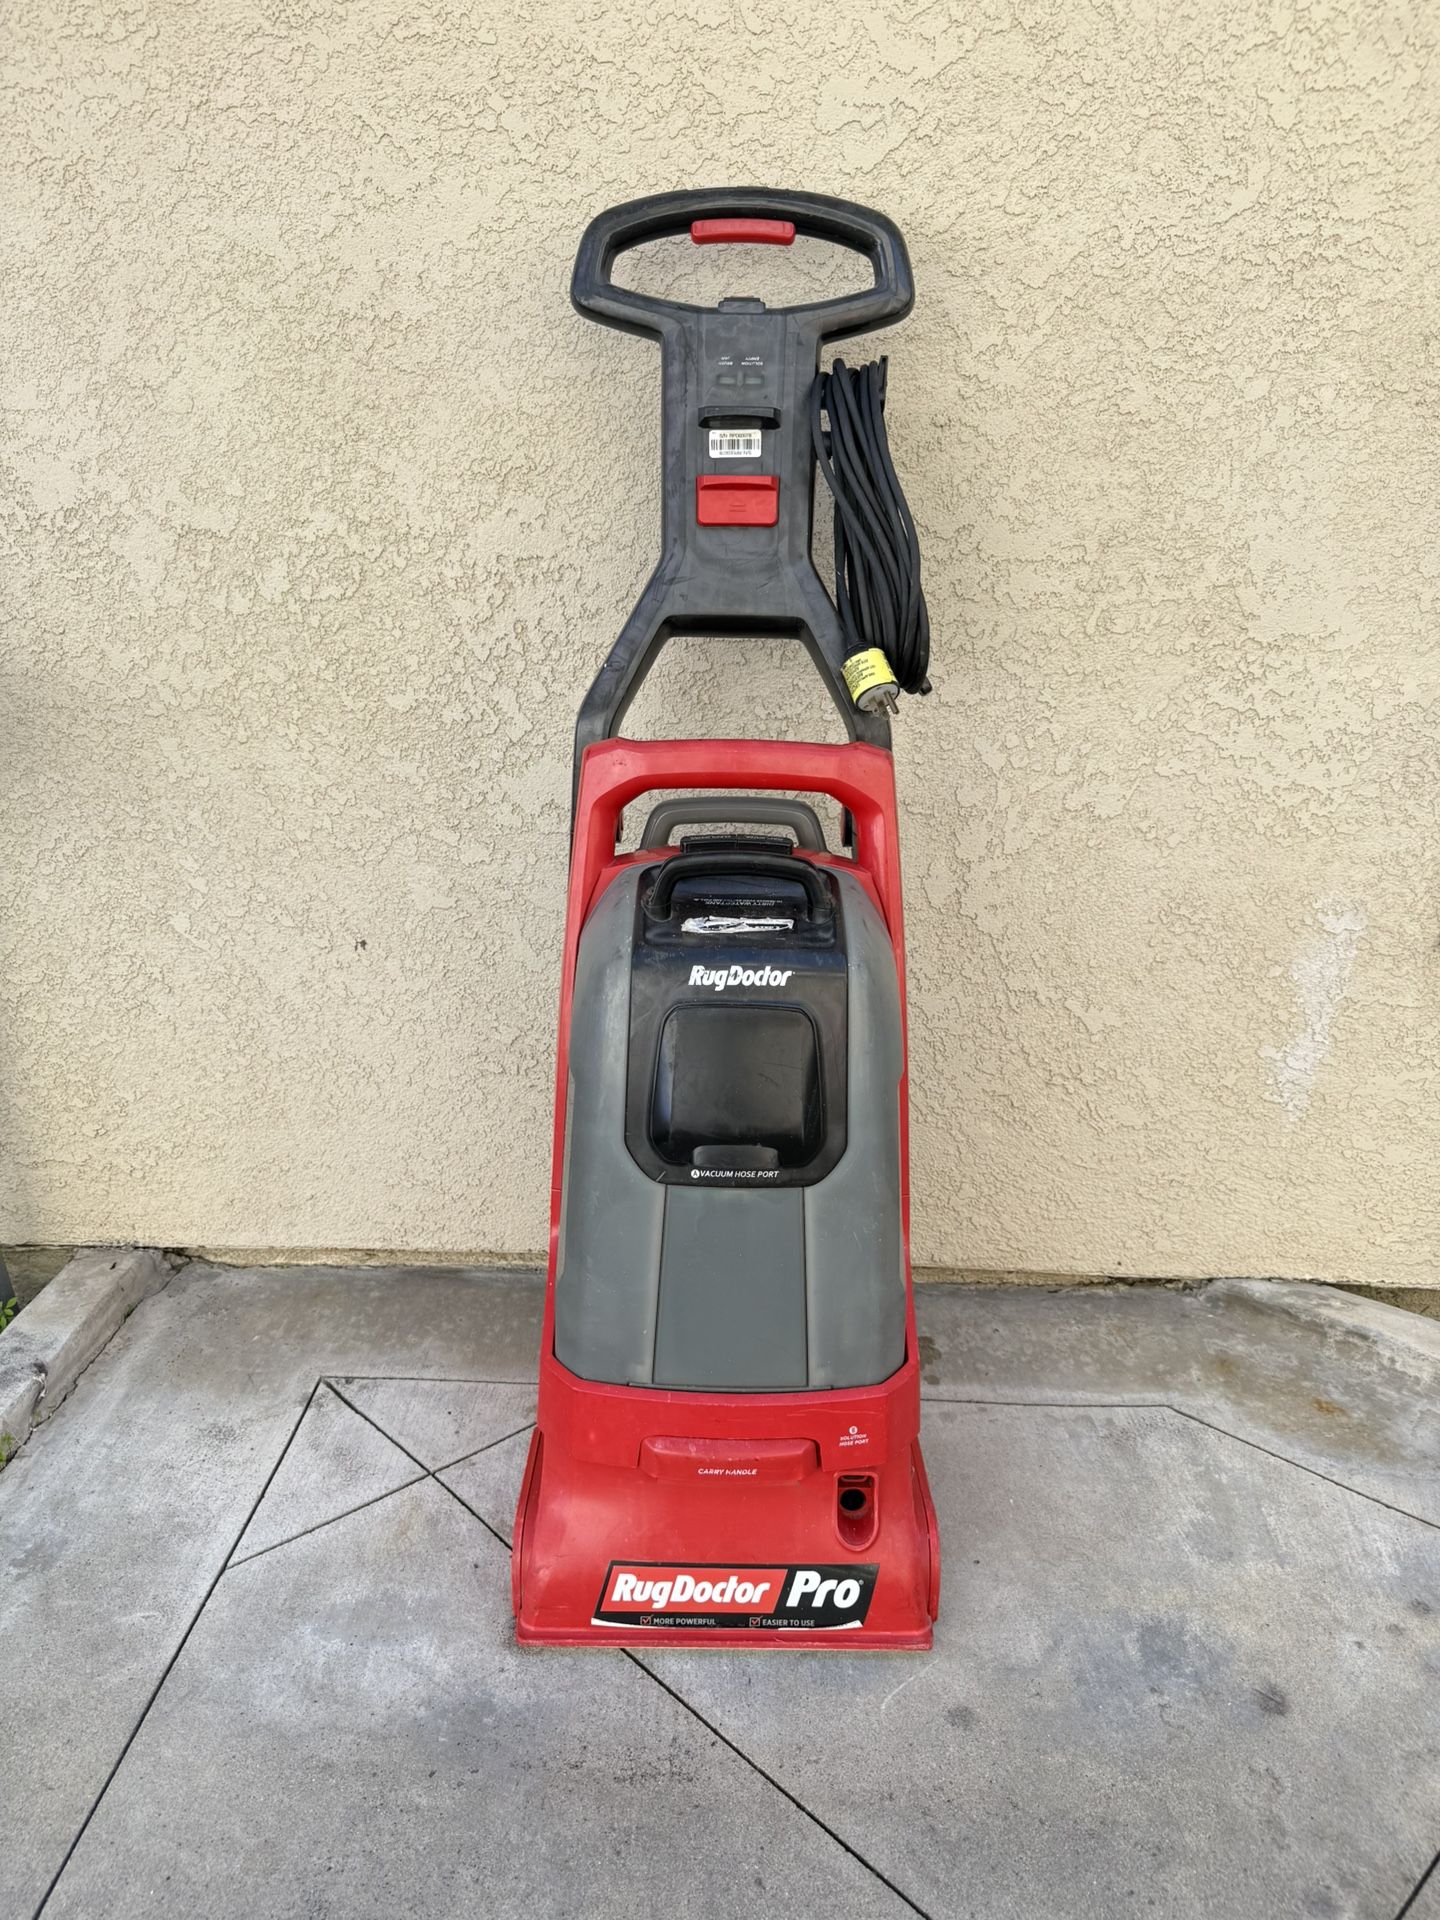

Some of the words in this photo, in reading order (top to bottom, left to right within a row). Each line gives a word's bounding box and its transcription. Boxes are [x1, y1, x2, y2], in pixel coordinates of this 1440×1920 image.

[688, 965, 792, 991] RugDoctor
[700, 1170, 733, 1178] VACUUM
[840, 1433, 867, 1441] SOLUTION
[725, 1468, 757, 1476] HANDLE
[611, 1573, 771, 1609] RugDoctor
[785, 1570, 861, 1609] Pro
[653, 1617, 675, 1625] MORE
[676, 1617, 716, 1625] POWERFUL
[762, 1618, 789, 1627] EASIER
[790, 1618, 800, 1627] TO
[800, 1618, 815, 1627] USE
